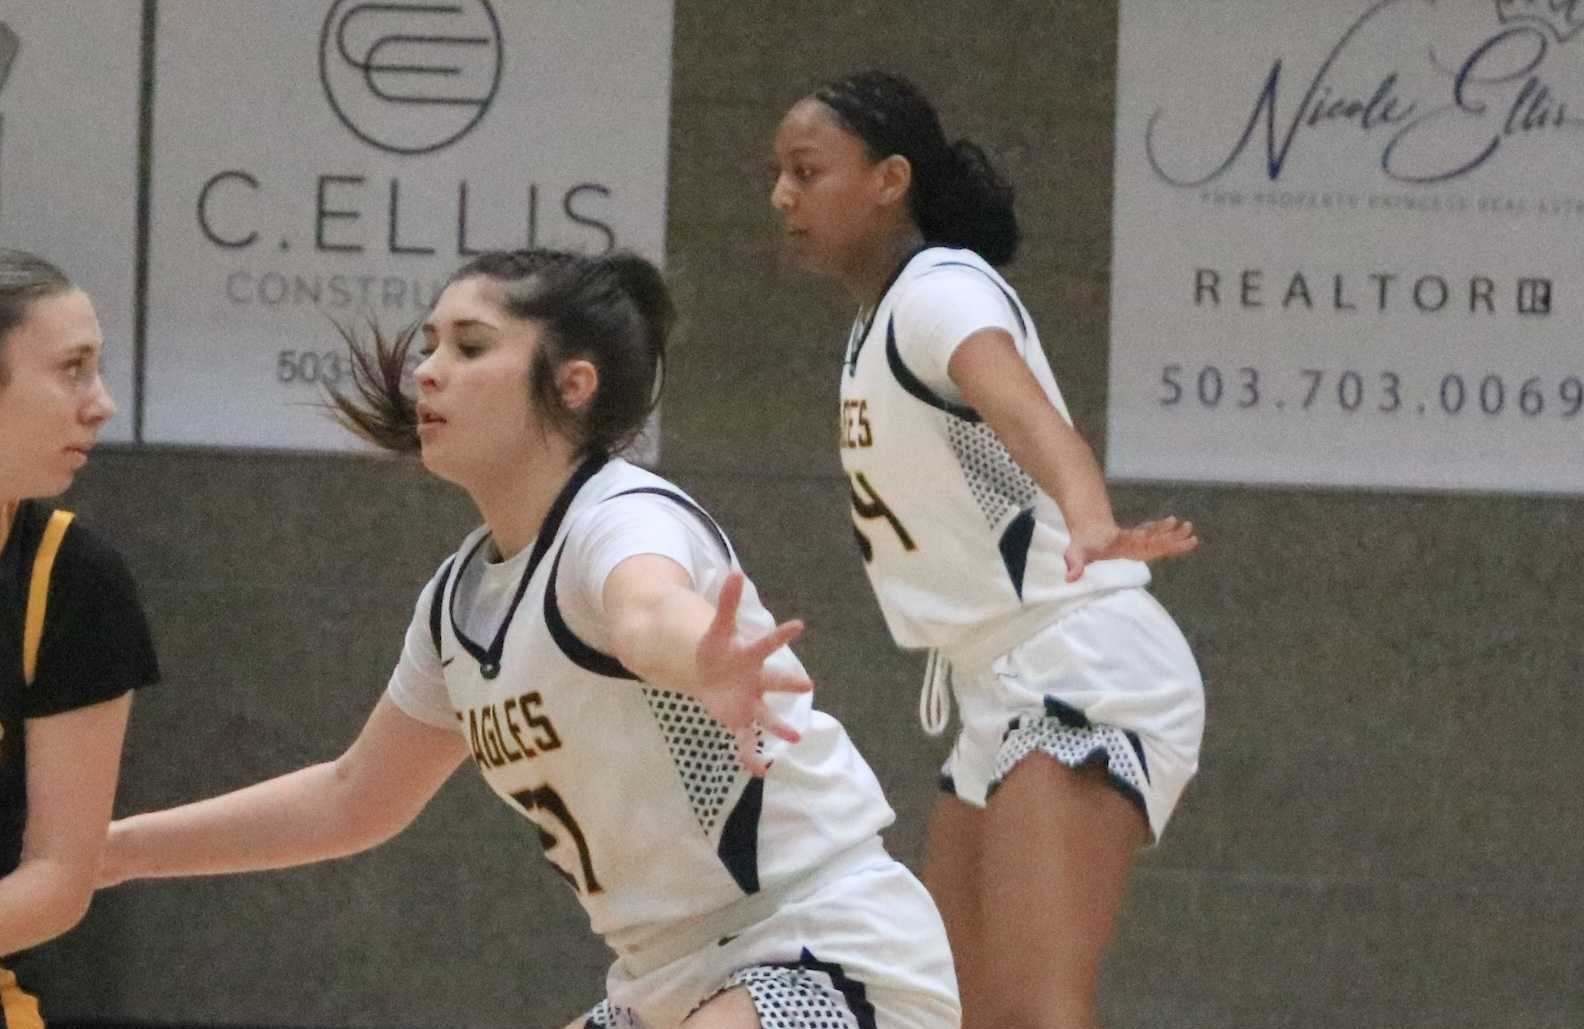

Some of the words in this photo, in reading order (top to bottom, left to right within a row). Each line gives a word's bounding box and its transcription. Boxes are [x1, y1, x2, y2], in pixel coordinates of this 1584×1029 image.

[1145, 0, 1414, 187] Nicole
[1382, 27, 1584, 184] Ellis
[198, 170, 614, 255] C.ELLIS
[224, 270, 440, 310] CONSTRU
[1158, 365, 1584, 418] 503.703.0069
[455, 690, 563, 771] AGLES
